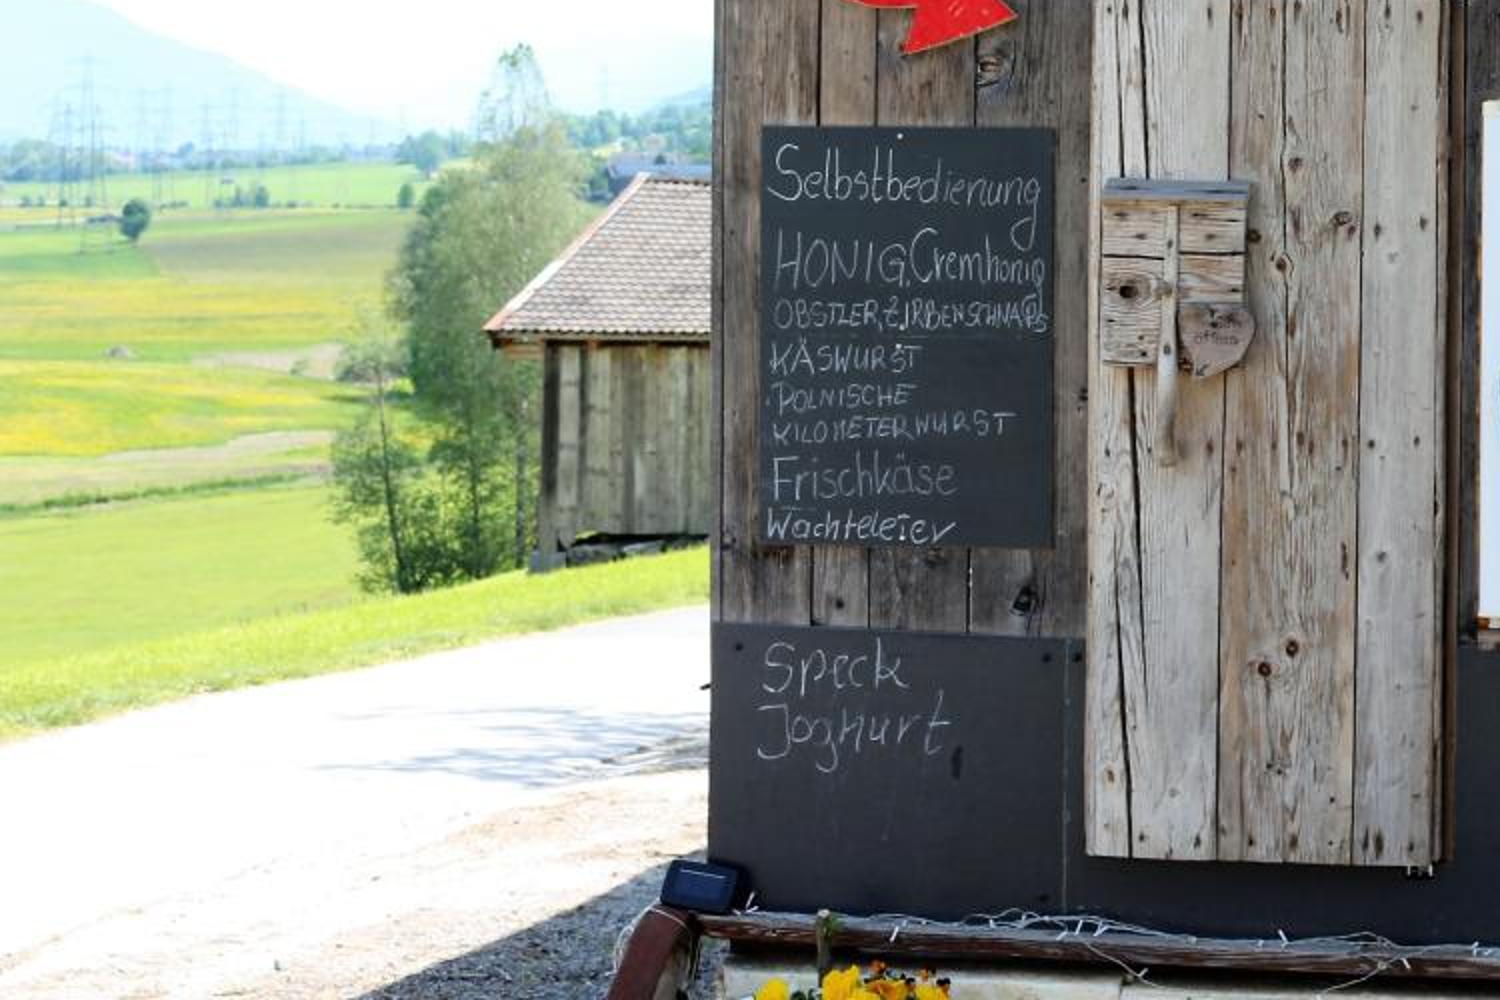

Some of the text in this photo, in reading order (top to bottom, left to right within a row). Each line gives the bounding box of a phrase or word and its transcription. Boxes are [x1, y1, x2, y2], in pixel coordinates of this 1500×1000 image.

[768, 143, 1041, 251] Selbstbedienung
[769, 337, 923, 376] KÄSWURST
[771, 381, 917, 416] POLNISCHE
[773, 450, 959, 501] Frischkäse
[767, 506, 956, 545] Wachteleier
[762, 637, 909, 696] Speck
[757, 689, 950, 772] Joghurt
